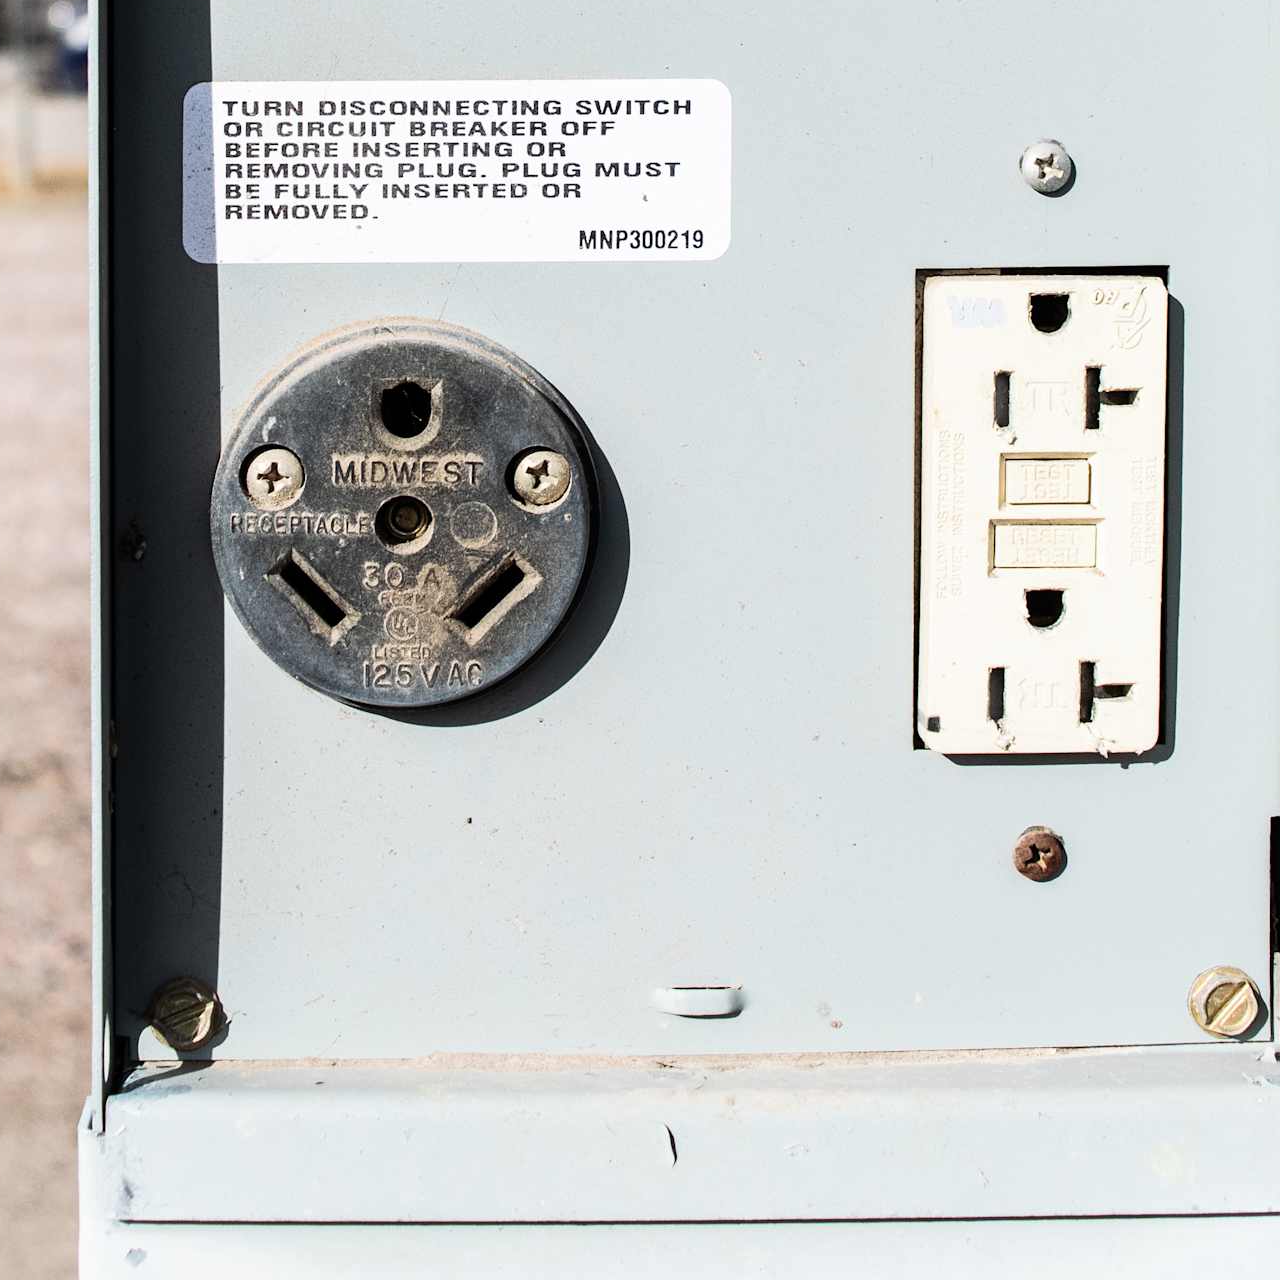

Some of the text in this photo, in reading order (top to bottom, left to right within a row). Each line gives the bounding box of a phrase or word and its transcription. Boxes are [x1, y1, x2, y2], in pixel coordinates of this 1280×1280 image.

[223, 99, 692, 117] TURN DISCONNECTING SWITCH
[223, 121, 616, 137] OR CIRCUIT BREAKER OFF
[225, 142, 567, 158] BEFORE INSERTING OR
[225, 162, 682, 179] REMOVING PLUG. PLUG MUST
[225, 182, 581, 200] BE FULLY INSERTED OR
[225, 205, 378, 220] REMOVED.
[580, 230, 704, 249] MNP300219
[333, 460, 484, 486] MIDWEST
[1020, 464, 1076, 481] TEST
[230, 513, 373, 535] RECEPTACLE
[363, 561, 441, 591] 30 A
[371, 646, 432, 660] LISTED
